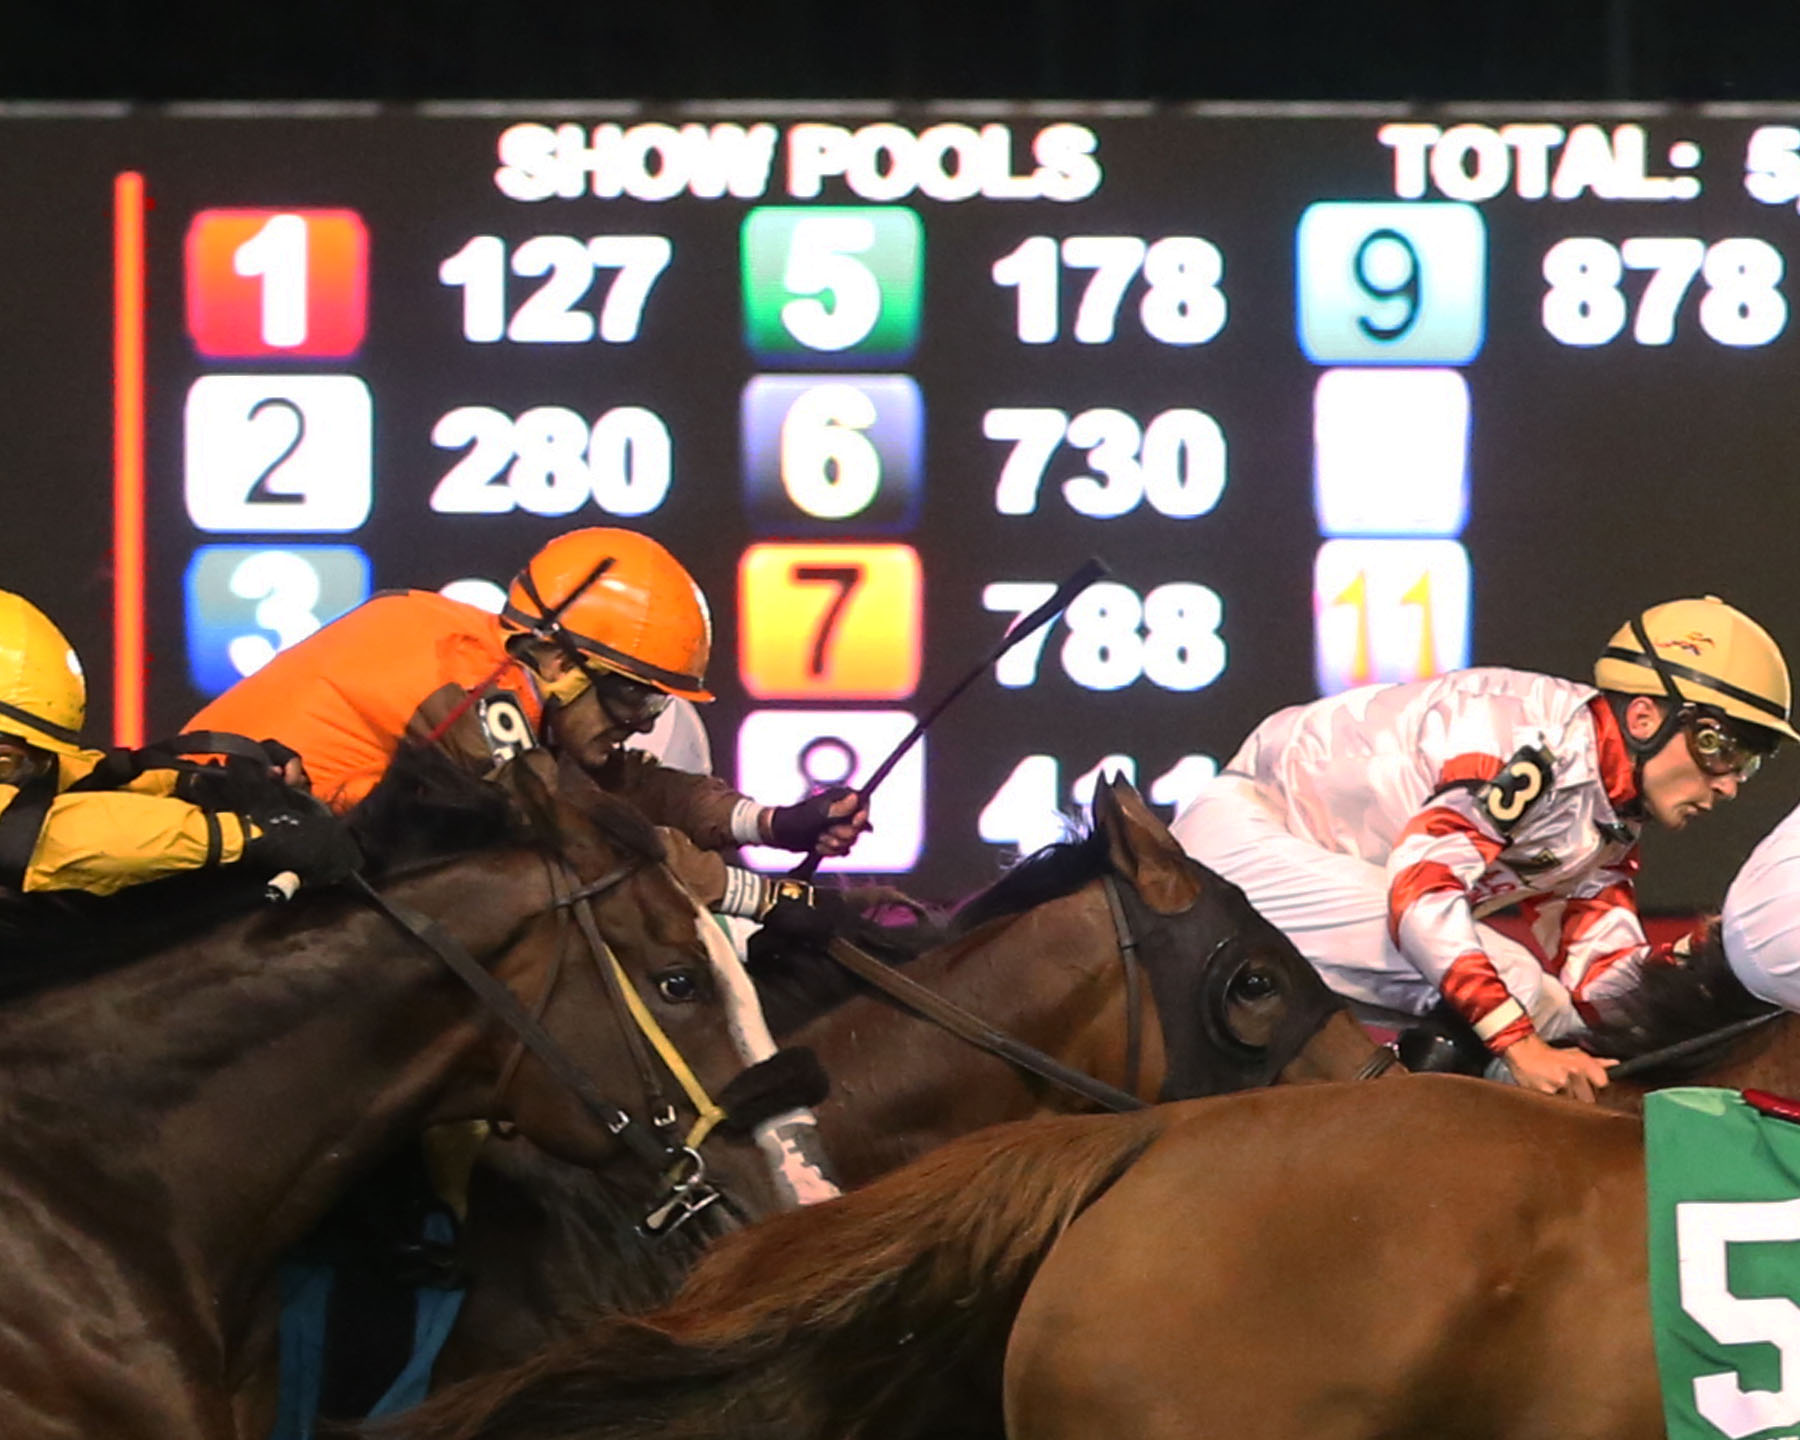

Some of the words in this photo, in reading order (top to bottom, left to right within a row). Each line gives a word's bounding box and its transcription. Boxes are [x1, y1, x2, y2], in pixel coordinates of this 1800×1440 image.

[495, 123, 777, 202] SHOW
[788, 124, 1101, 202] POOLS
[1379, 125, 1700, 200] TOTAL:
[234, 214, 307, 347] 1
[439, 235, 671, 343] 127
[781, 218, 881, 350] 5
[992, 235, 1227, 344] 178
[1353, 228, 1423, 344] 9
[1542, 237, 1786, 346] 878
[244, 397, 307, 504] 2
[430, 406, 671, 516] 280
[781, 385, 881, 518] 6
[983, 408, 1227, 518] 730
[228, 550, 320, 677] 3
[790, 567, 860, 677] 7
[983, 582, 1227, 691] 788
[1332, 570, 1437, 684] 11
[487, 701, 534, 762] 9
[1487, 760, 1542, 821] 3
